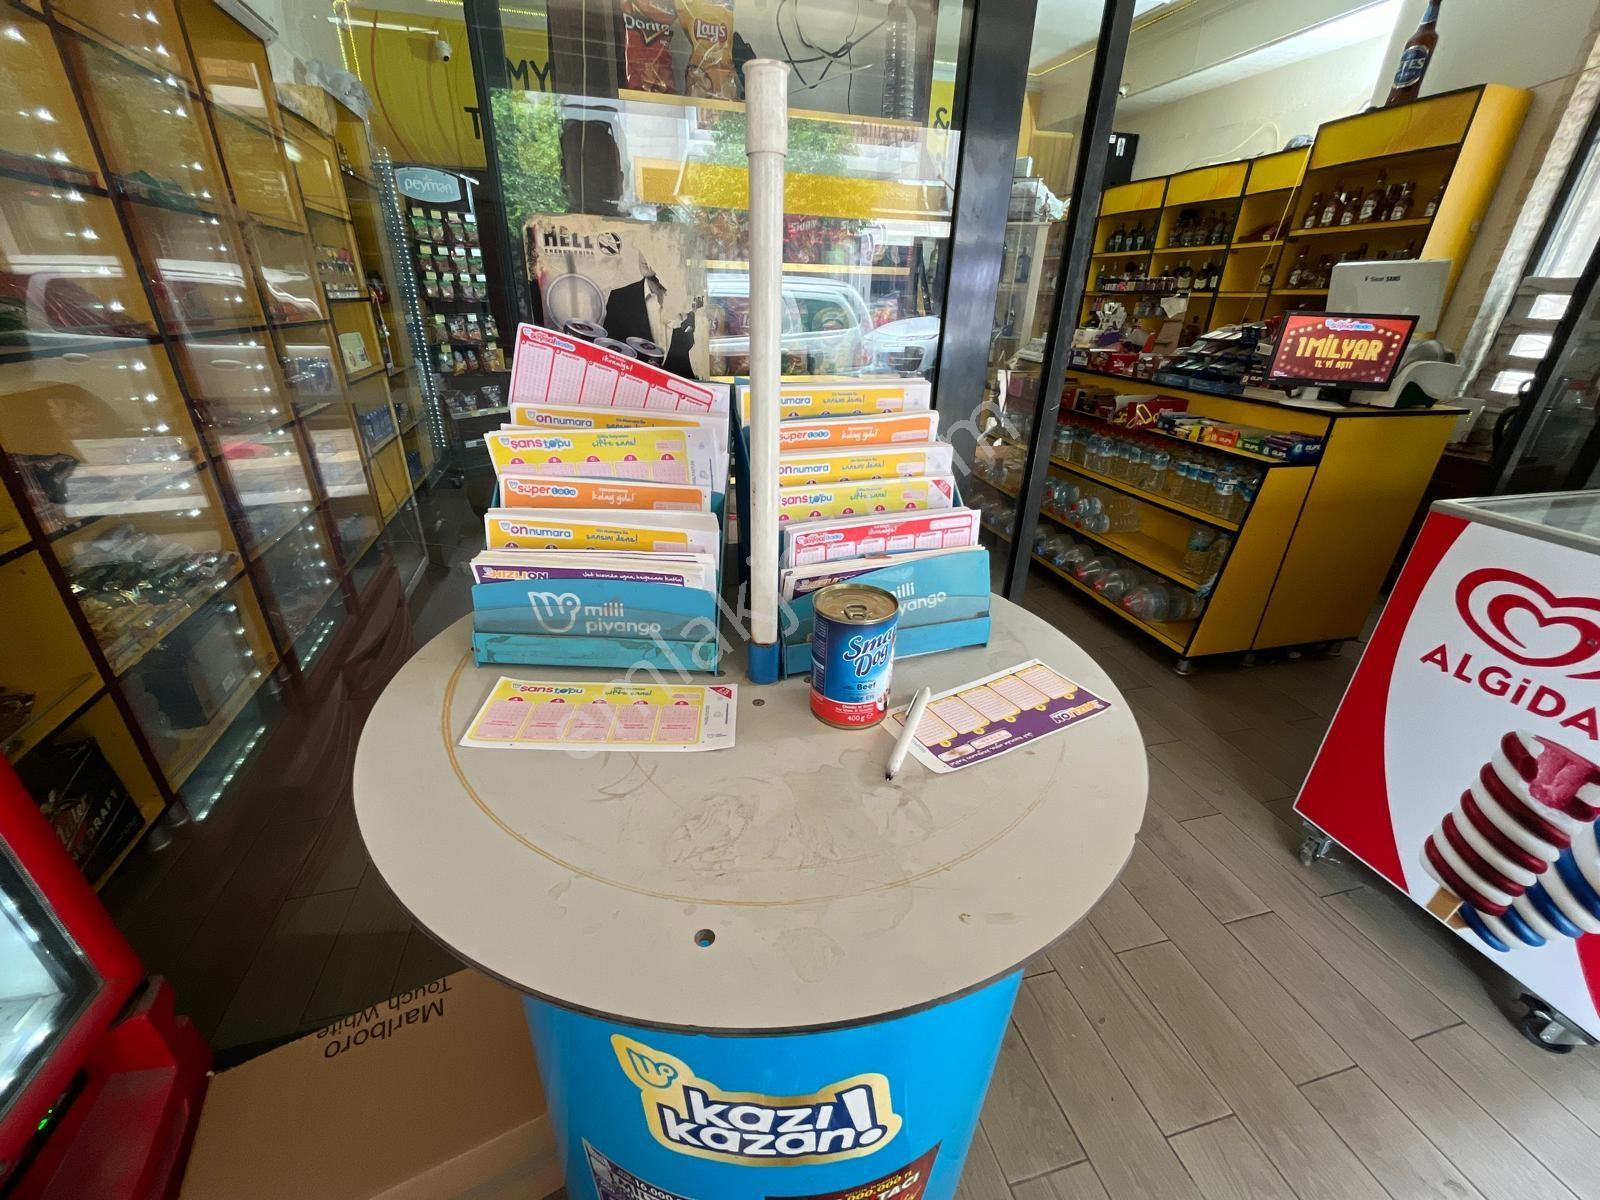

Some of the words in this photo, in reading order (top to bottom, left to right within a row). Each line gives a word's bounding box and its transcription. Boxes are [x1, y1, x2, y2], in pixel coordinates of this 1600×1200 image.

[696, 20, 727, 41] Lay's
[404, 177, 453, 193] peyman
[781, 396, 811, 405] umara
[584, 602, 624, 617] milli
[898, 591, 947, 617] yango
[853, 645, 889, 678] Dog
[857, 682, 876, 690] Beef
[389, 977, 452, 1010] Touch
[317, 1005, 379, 1040] White
[324, 999, 444, 1058] Marlboro
